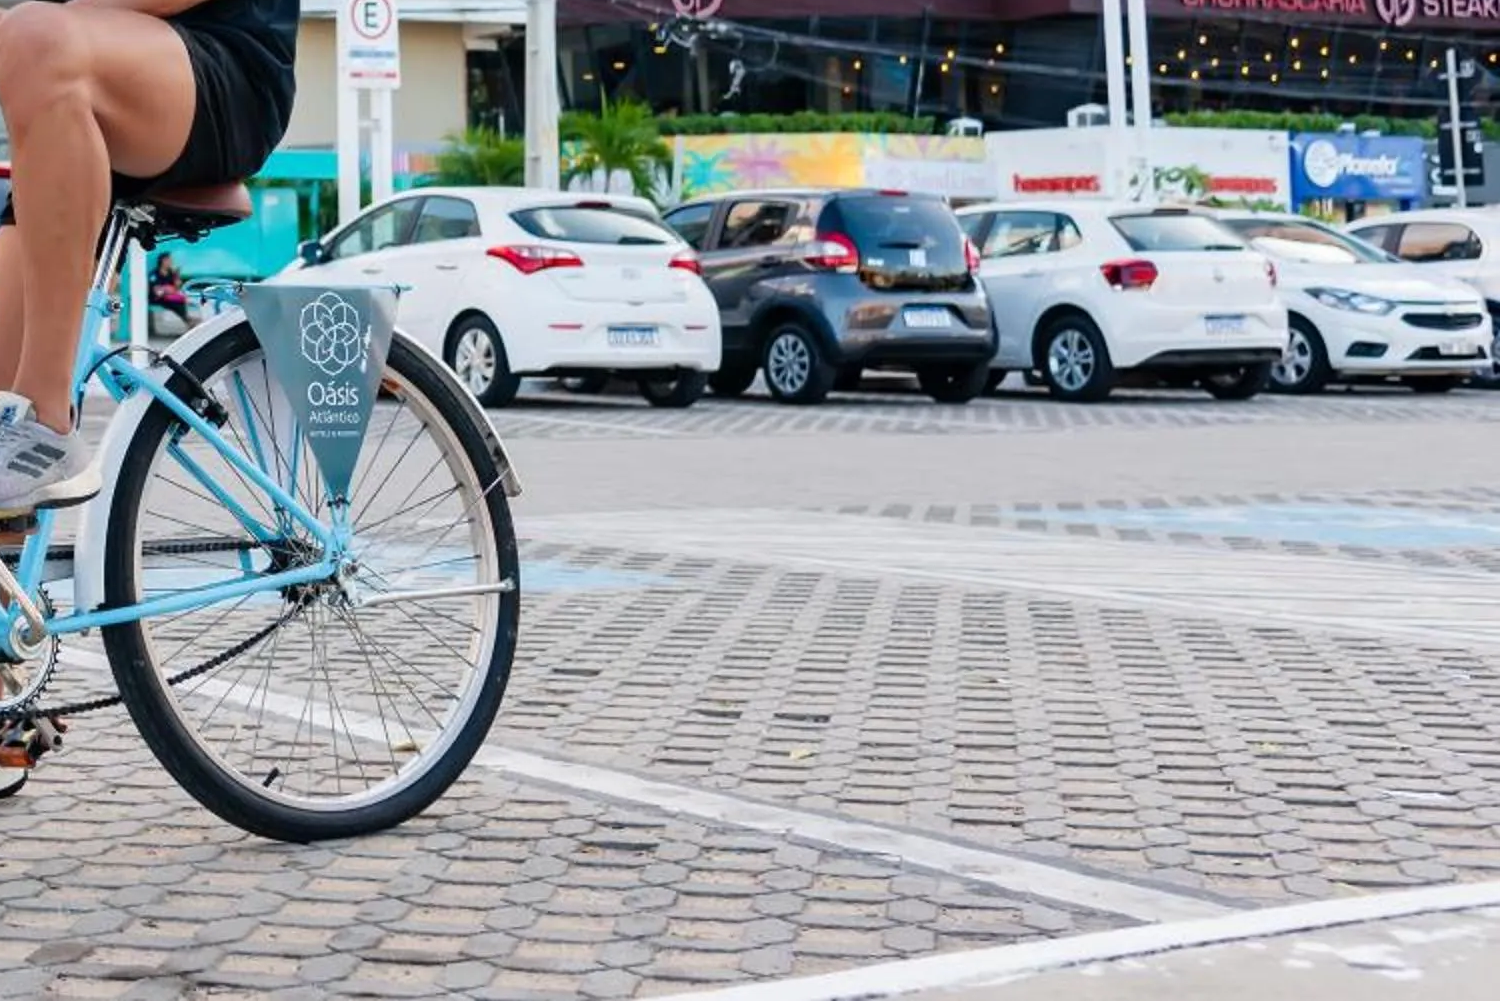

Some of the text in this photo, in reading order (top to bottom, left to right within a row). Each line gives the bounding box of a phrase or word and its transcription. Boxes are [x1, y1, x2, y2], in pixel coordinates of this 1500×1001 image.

[364, 1, 378, 28] E
[307, 380, 359, 406] Oásis
[309, 410, 360, 424] Atlântico
